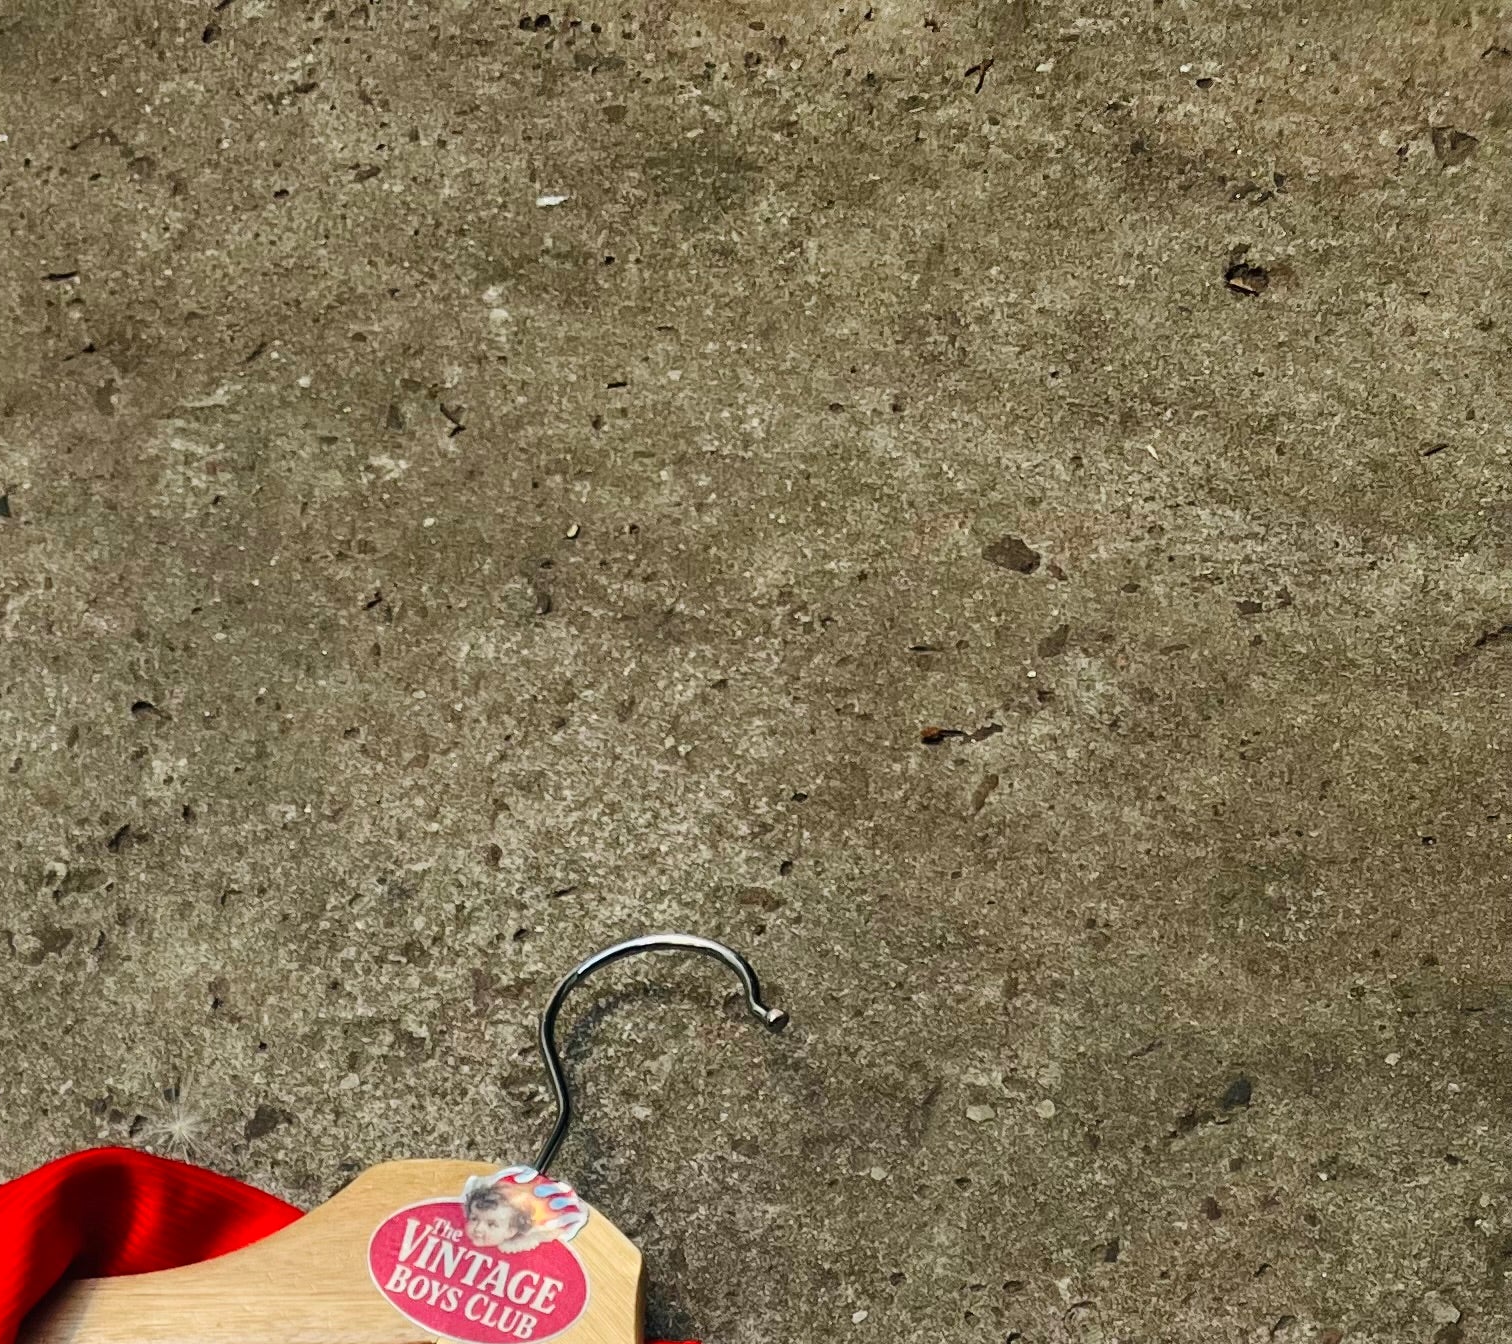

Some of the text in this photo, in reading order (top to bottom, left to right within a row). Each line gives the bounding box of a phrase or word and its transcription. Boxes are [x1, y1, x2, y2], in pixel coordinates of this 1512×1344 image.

[397, 1218, 564, 1315] VINTAGE
[433, 1216, 463, 1243] The
[385, 1265, 539, 1340] BOYS CLUB
